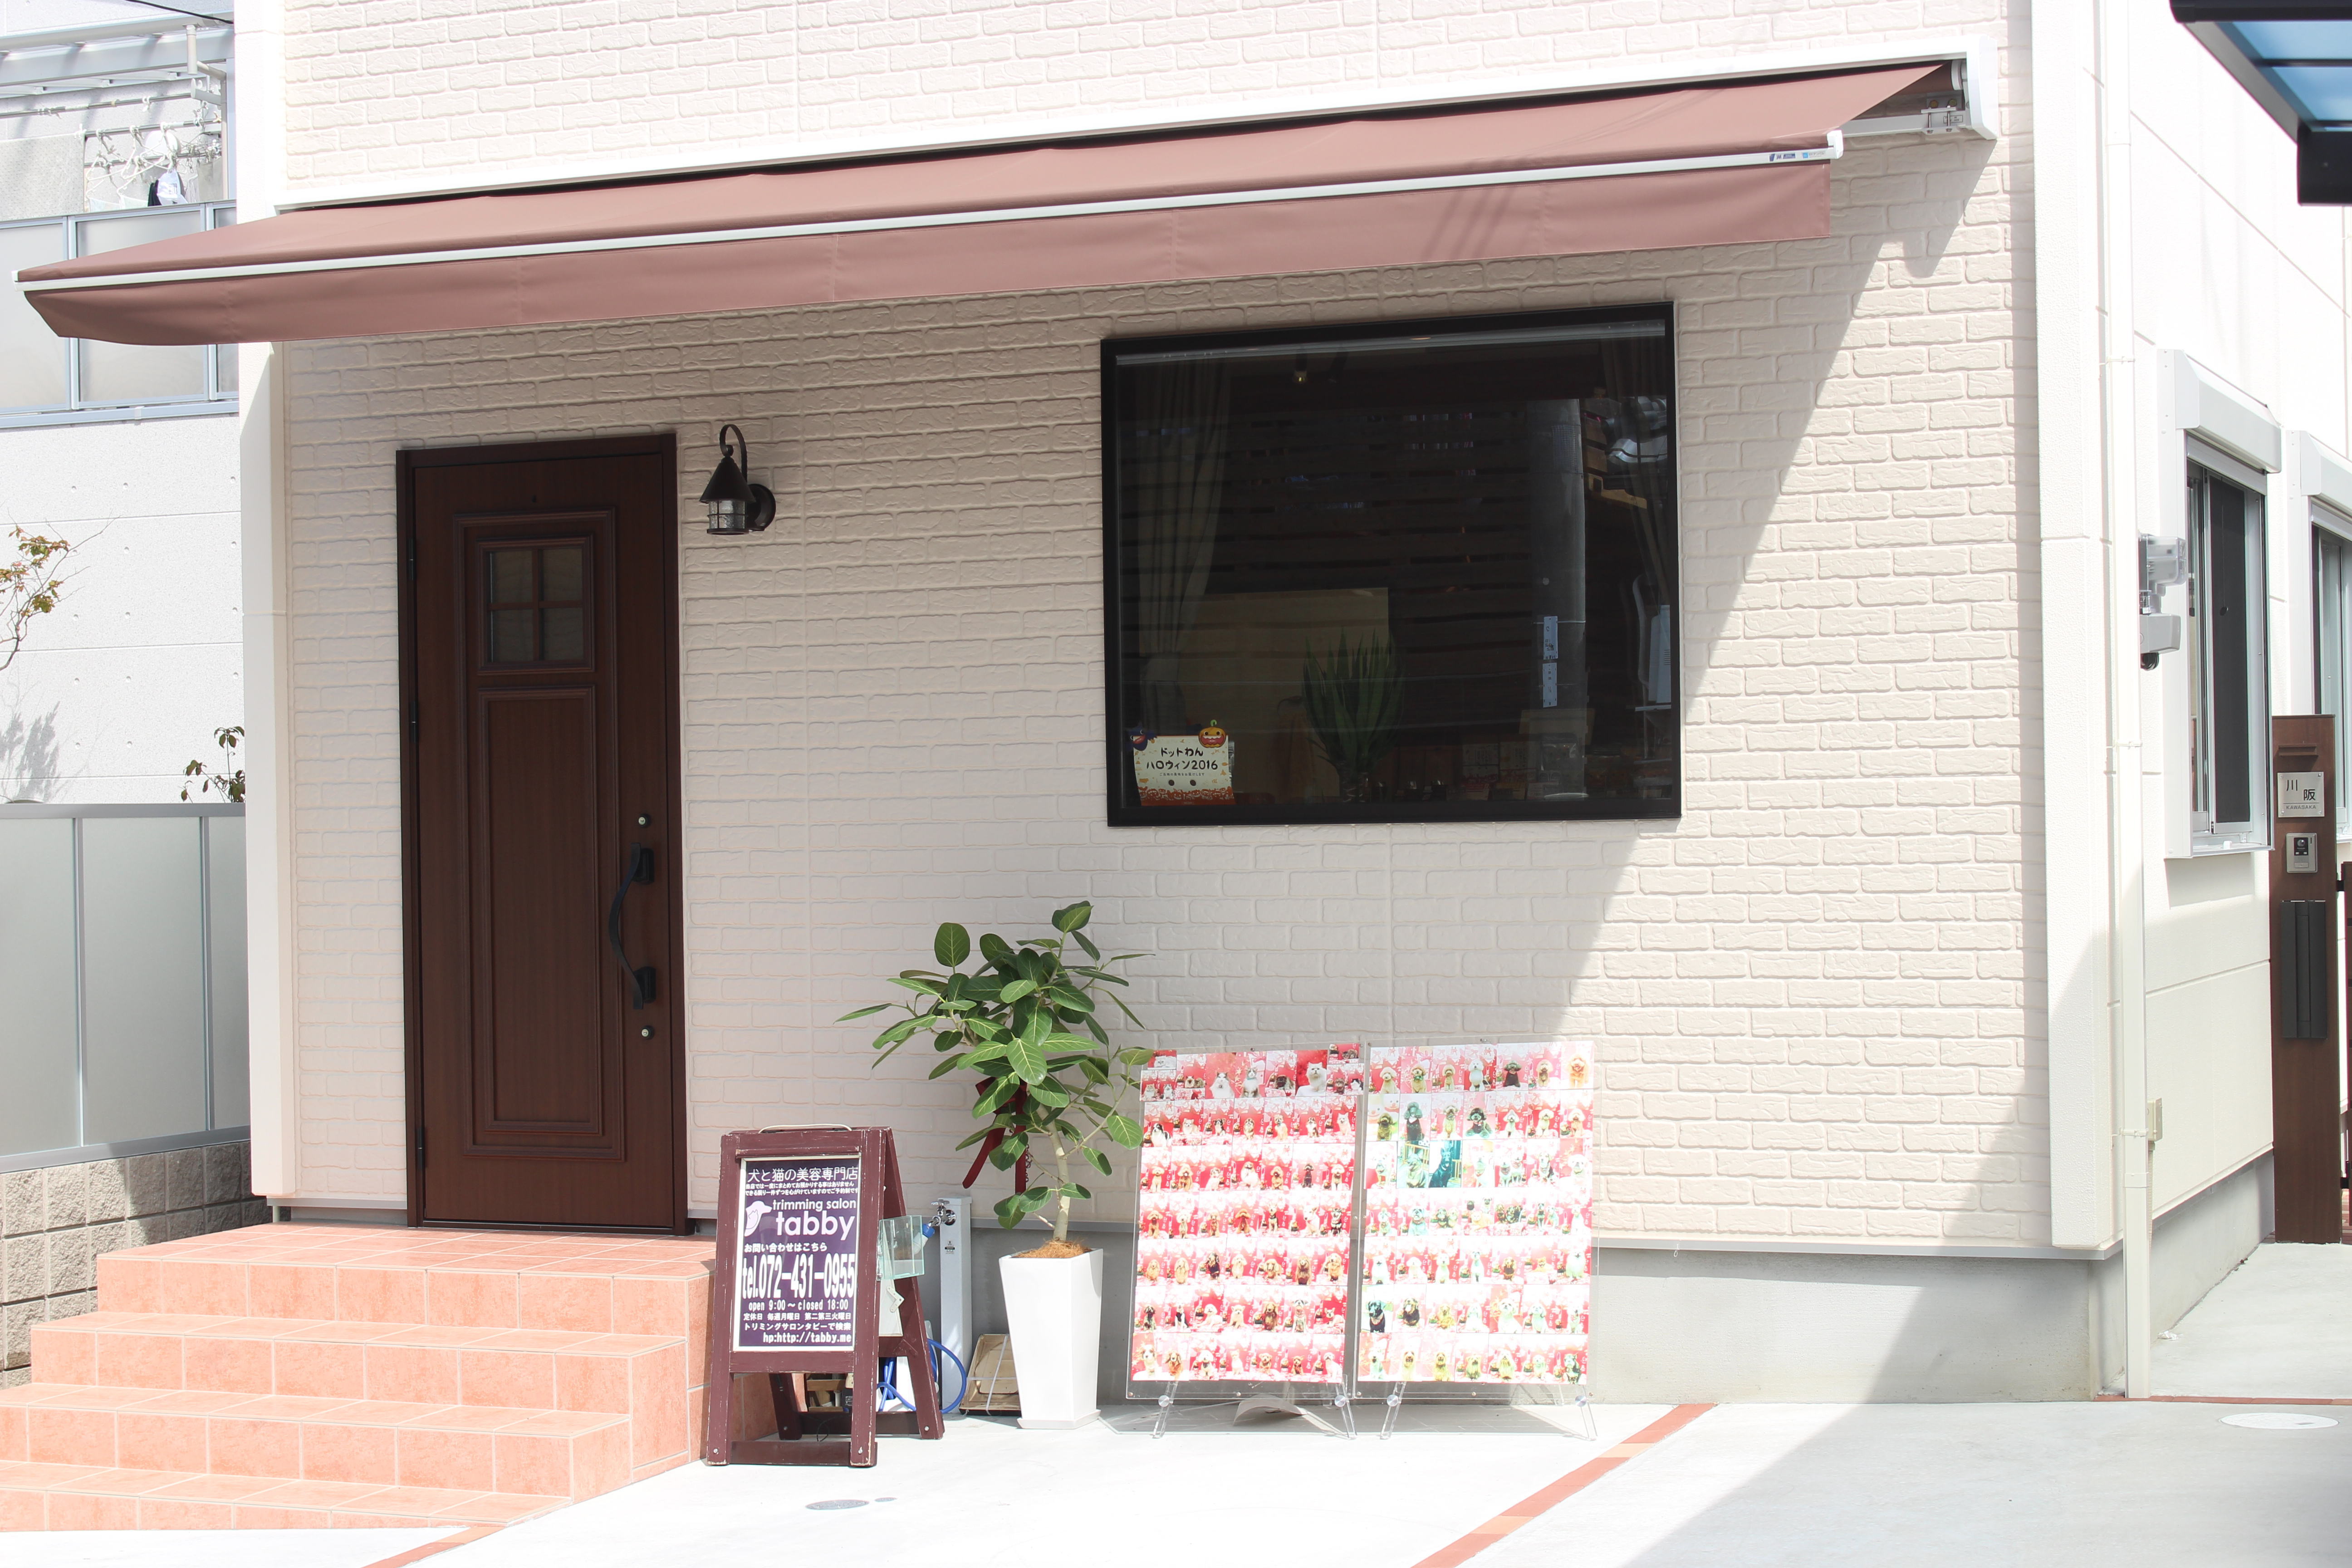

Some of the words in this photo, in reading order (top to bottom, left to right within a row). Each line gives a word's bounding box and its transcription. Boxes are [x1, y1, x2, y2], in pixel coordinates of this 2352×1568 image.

[1161, 747, 1204, 757] ドットわん
[1147, 760, 1218, 770] ハロウィン2016
[748, 1166, 858, 1182] 犬と猫の美容専門店
[773, 1199, 823, 1212] trimming
[826, 1198, 856, 1209] salon
[776, 1210, 855, 1240] tabby
[744, 1242, 828, 1253] お問い合わせはこちら
[749, 1301, 765, 1312] open
[827, 1299, 848, 1310] 18:00
[743, 1313, 763, 1321] 定休日
[767, 1312, 800, 1321] 毎週月曜日
[804, 1312, 851, 1321] 第二第三火曜日
[763, 1331, 852, 1343] hp:http://tabby.me
